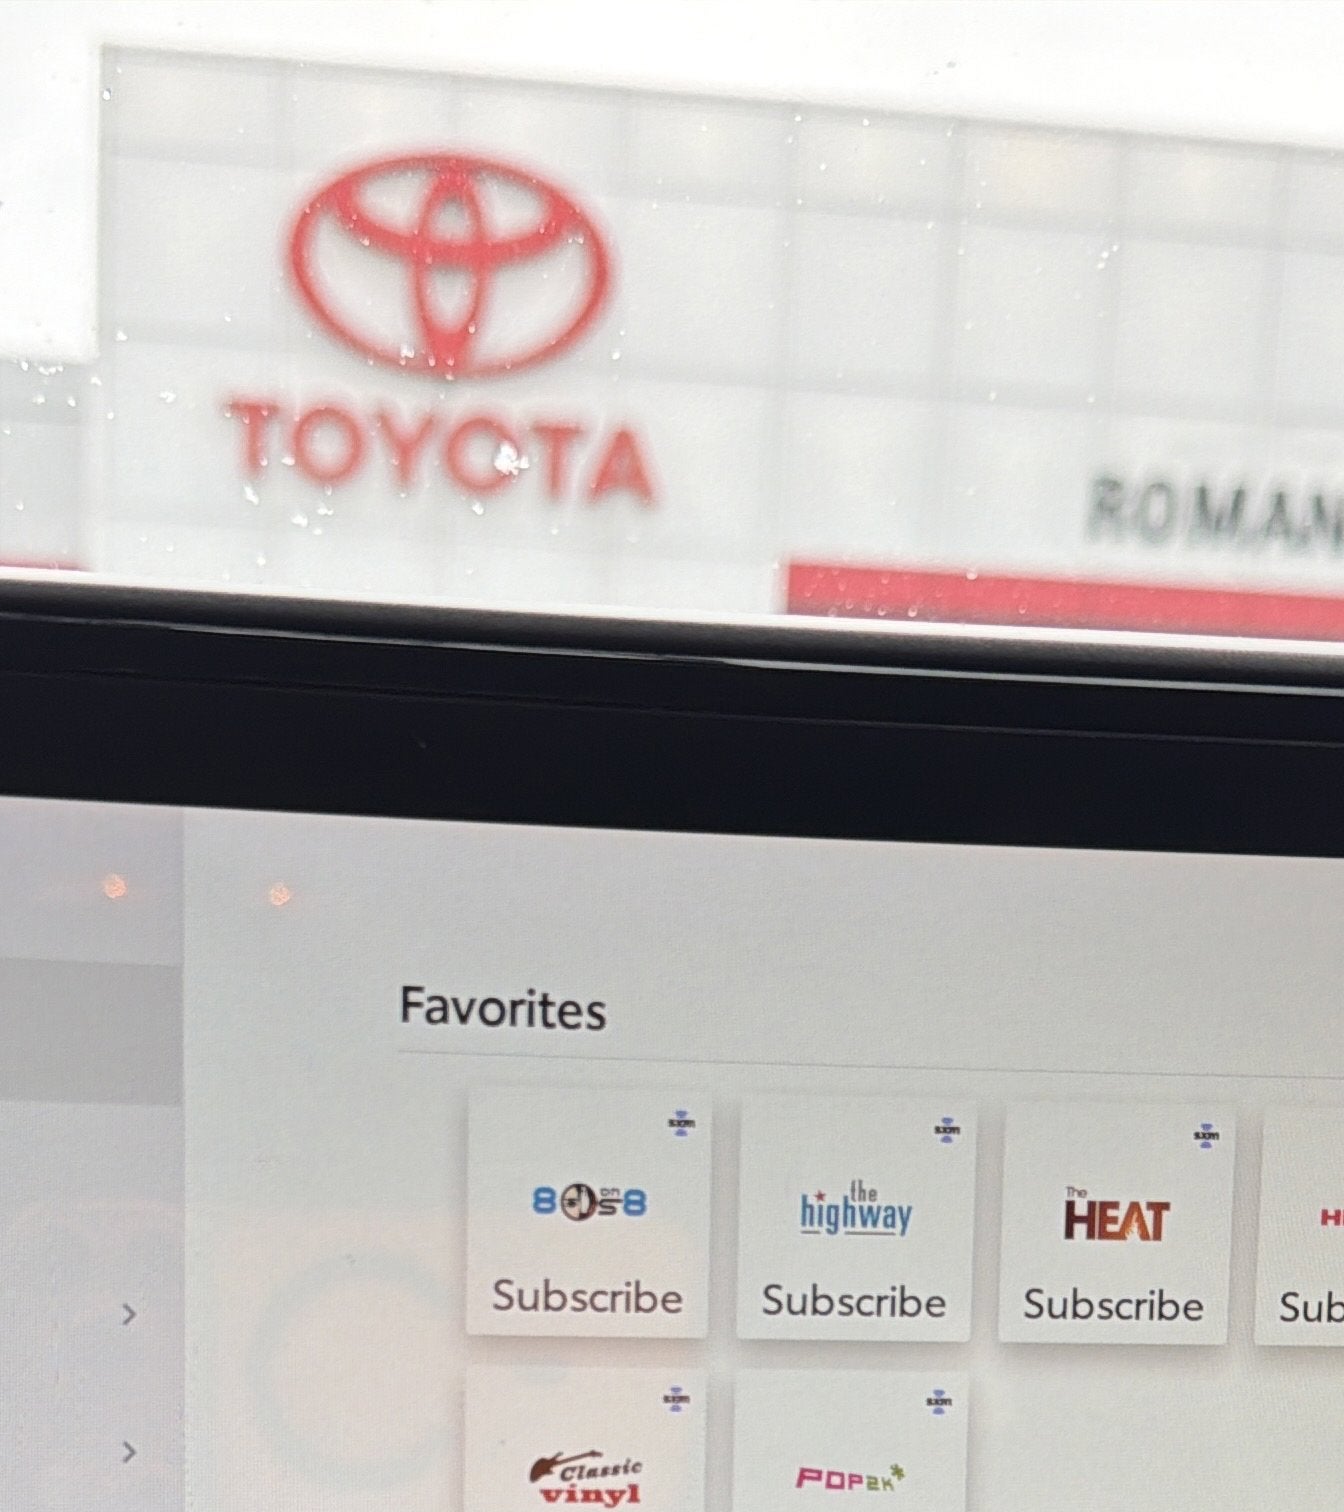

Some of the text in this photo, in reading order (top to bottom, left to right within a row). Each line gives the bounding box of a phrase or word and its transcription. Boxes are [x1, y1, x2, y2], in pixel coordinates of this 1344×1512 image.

[224, 395, 659, 510] TOYOTA
[402, 986, 605, 1030] Favorites
[850, 1180, 877, 1202] the
[800, 1193, 913, 1237] highway
[1065, 1201, 1170, 1240] HEAT
[493, 1278, 682, 1313] Subscribe
[763, 1283, 946, 1317] Subscribe
[1025, 1288, 1203, 1321] Subscribe
[560, 1457, 643, 1482] Classic
[540, 1484, 640, 1508] vinyl
